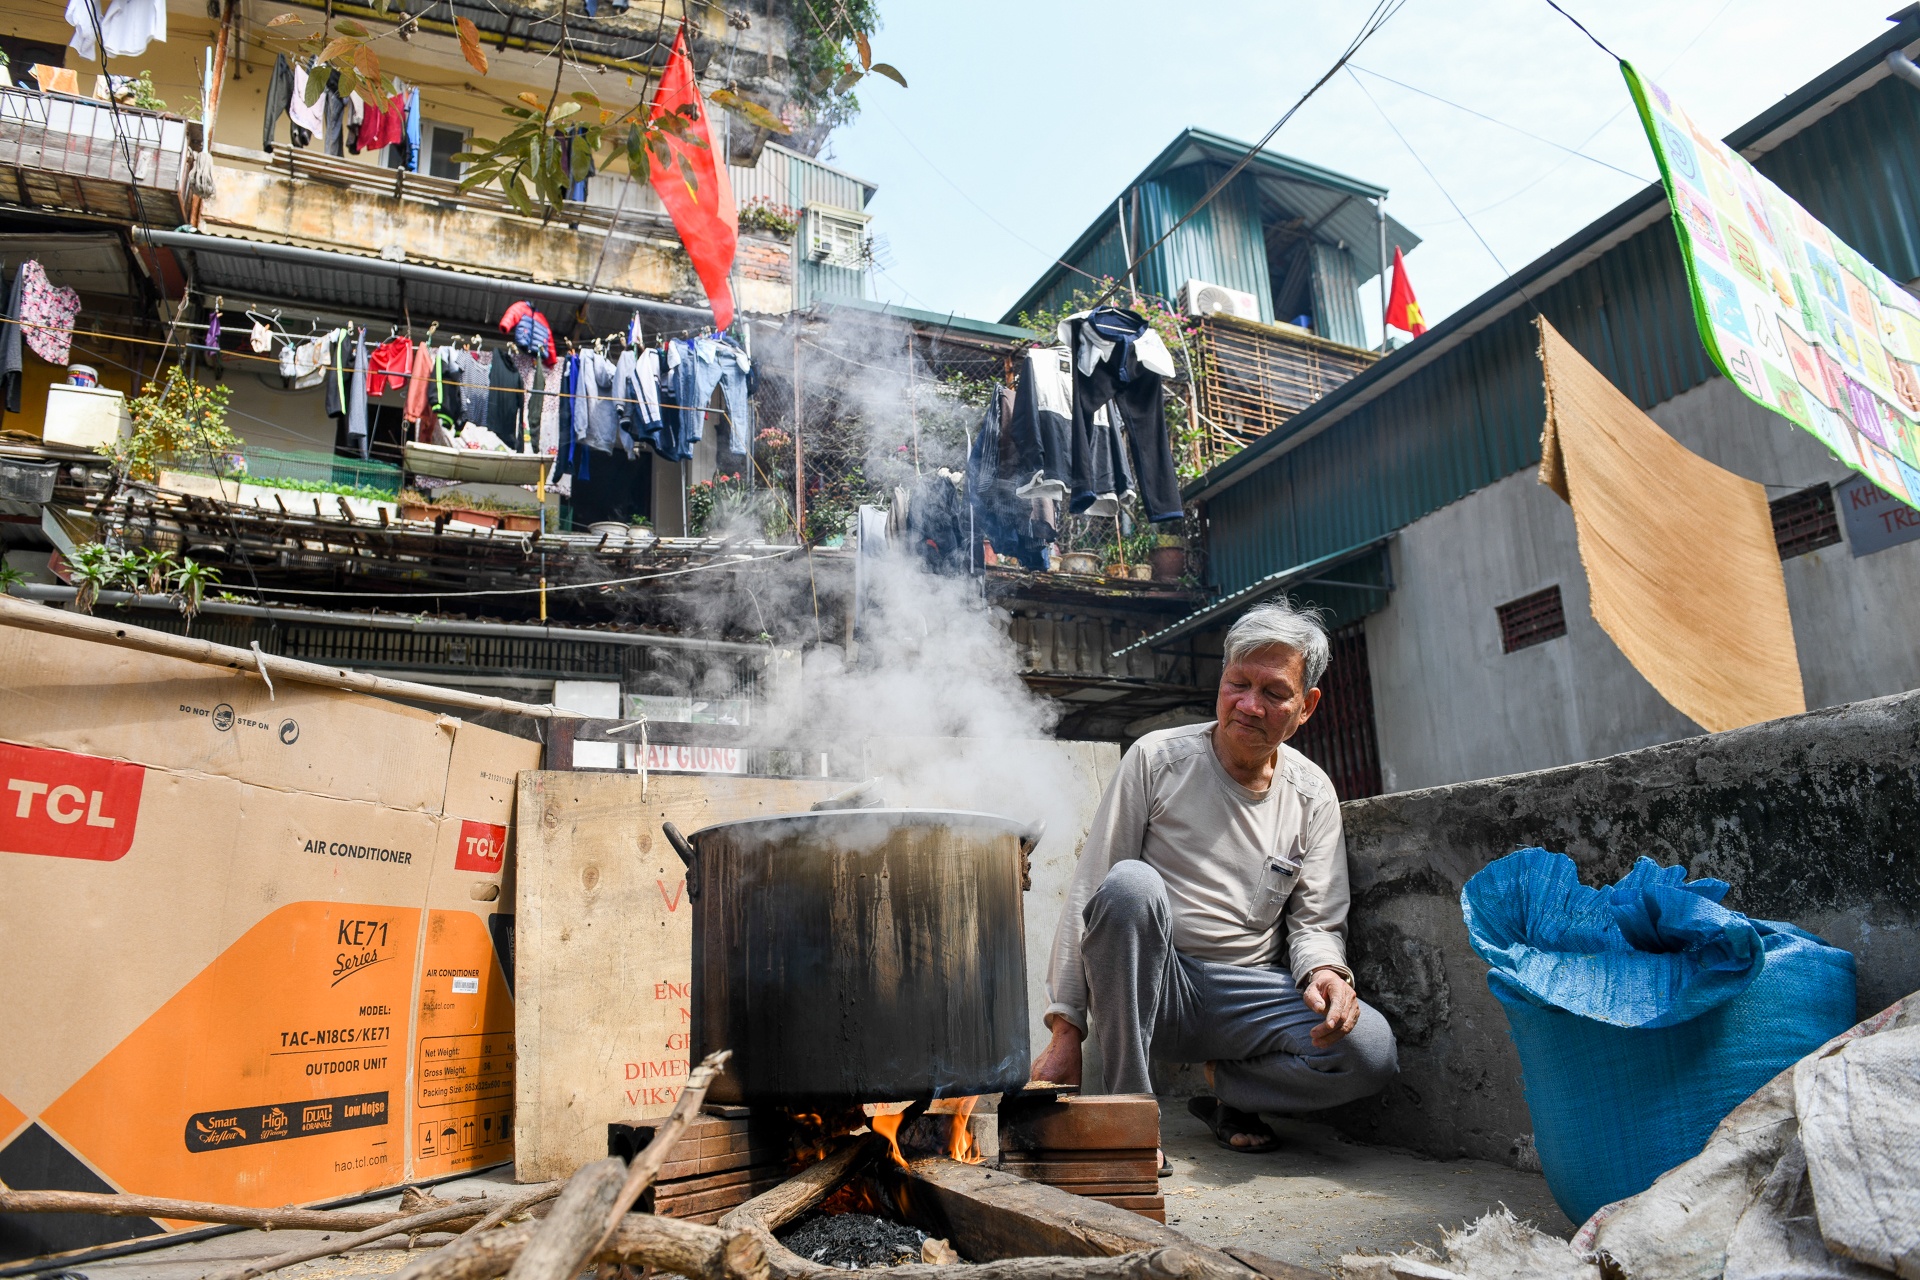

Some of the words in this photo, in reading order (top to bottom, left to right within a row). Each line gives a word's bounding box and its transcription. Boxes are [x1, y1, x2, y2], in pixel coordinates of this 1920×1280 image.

[1879, 505, 1920, 534] TRE
[179, 704, 191, 713] DO
[192, 707, 210, 717] NOT
[237, 718, 257, 727] STEP
[258, 722, 269, 731] ON
[7, 778, 116, 829] TCL
[303, 839, 327, 854] AIR
[329, 842, 412, 865] CONDITIONER
[465, 836, 500, 859] TCL
[337, 919, 388, 947] KE71
[332, 947, 380, 977] Series
[426, 969, 438, 977] AIR
[438, 969, 480, 977] CONDITIONER
[359, 1005, 391, 1017] MODEL:
[280, 1026, 390, 1047] TAC-N18CS/KE71
[425, 1049, 436, 1058] Net
[437, 1047, 460, 1058] Weight:
[305, 1059, 360, 1076] OUTDOOR
[363, 1057, 388, 1071] UNIT
[424, 1069, 443, 1078] Gross
[444, 1066, 467, 1077] Weight:
[423, 1087, 448, 1097] Packing
[449, 1086, 463, 1095] Size:
[625, 1085, 687, 1106] VIKY
[306, 1109, 330, 1123] DUAL
[344, 1104, 361, 1118] Low
[362, 1101, 385, 1117] Noise
[208, 1116, 238, 1129] Smart
[262, 1110, 288, 1131] High
[334, 1153, 388, 1173] hao.tcl.com
